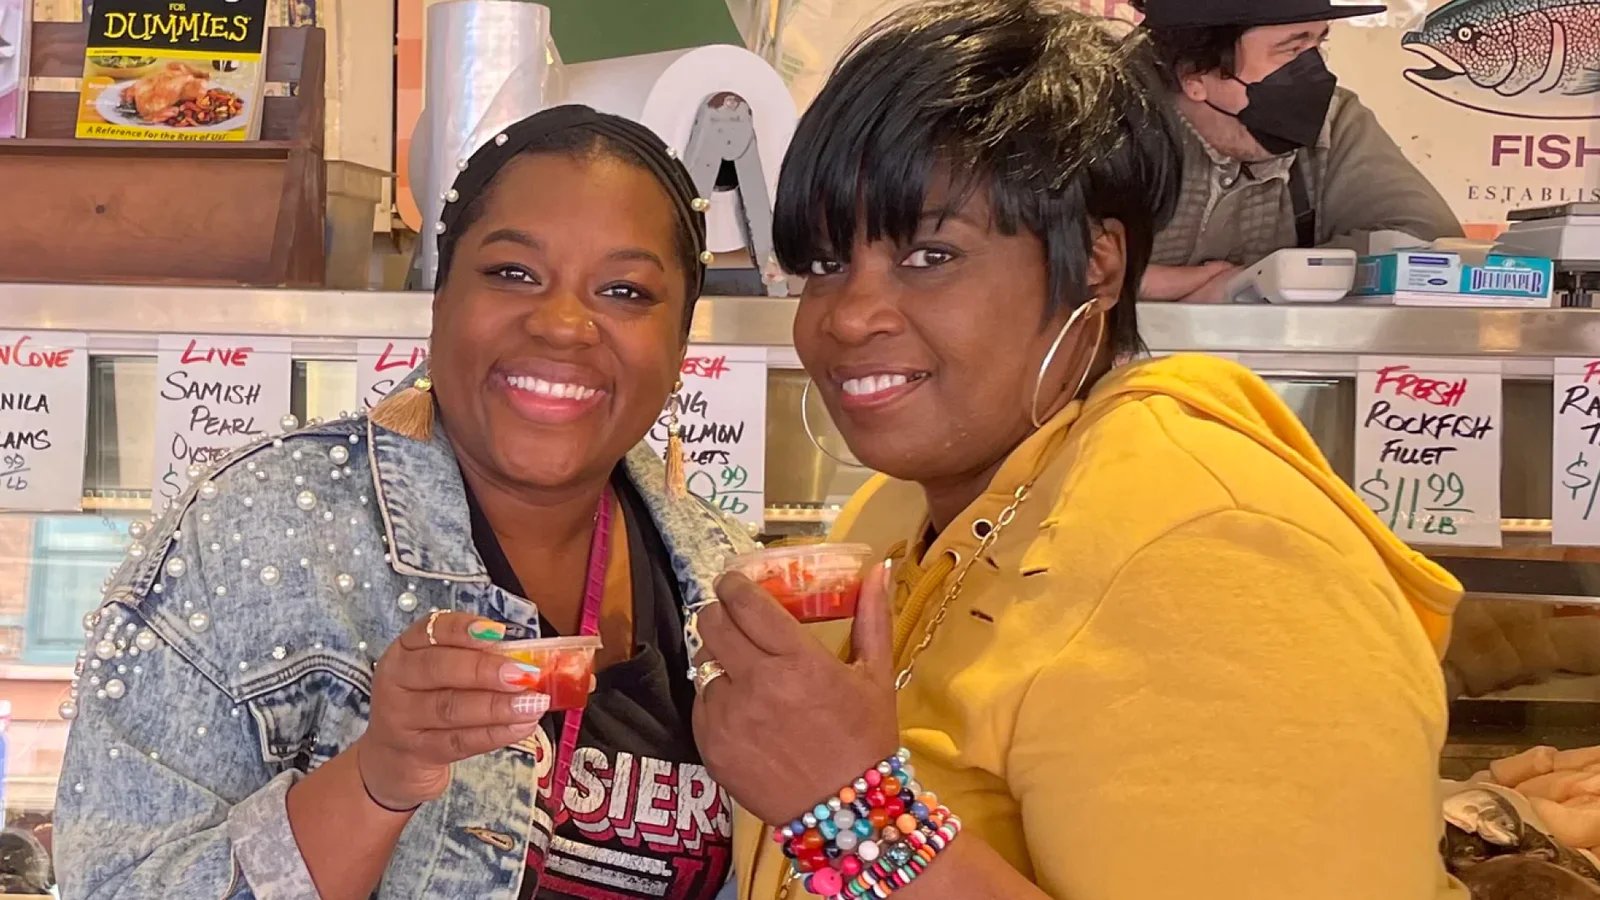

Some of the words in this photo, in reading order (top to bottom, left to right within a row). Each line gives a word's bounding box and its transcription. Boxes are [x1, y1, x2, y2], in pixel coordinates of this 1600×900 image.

[168, 3, 186, 12] FOR
[103, 12, 249, 43] DUMMIES
[87, 126, 93, 134] A
[95, 126, 141, 138] Reference
[144, 129, 158, 140] for
[160, 130, 175, 141] the
[177, 132, 198, 141] Rest
[1491, 134, 1600, 170] FISH
[181, 339, 253, 366] LIVE
[681, 356, 731, 379] ESH
[1583, 361, 1600, 385] F
[161, 371, 261, 405] SAMISH
[1374, 365, 1468, 407] FRESH
[190, 405, 263, 436] PEARL
[1364, 401, 1494, 439] ROCKFISH
[1380, 439, 1457, 465] FILLET
